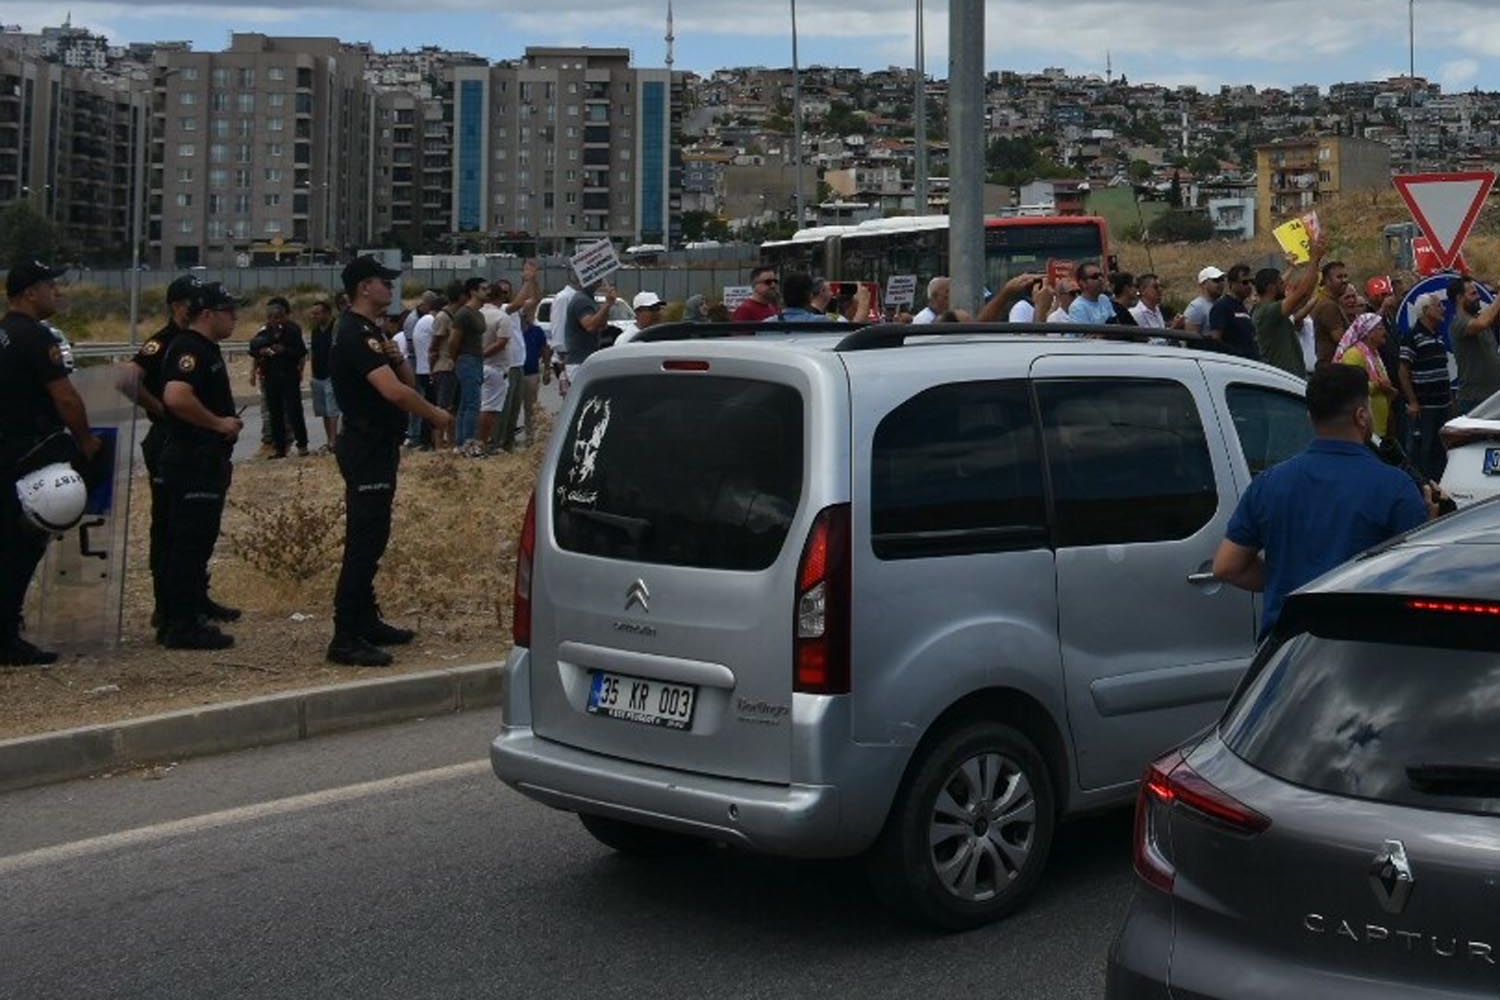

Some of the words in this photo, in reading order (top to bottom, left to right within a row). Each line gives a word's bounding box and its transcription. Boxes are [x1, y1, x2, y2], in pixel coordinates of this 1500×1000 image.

[601, 677, 620, 705] 35
[629, 681, 650, 711] KR
[659, 686, 691, 717] 003
[1303, 913, 1496, 964] CAPTUR
